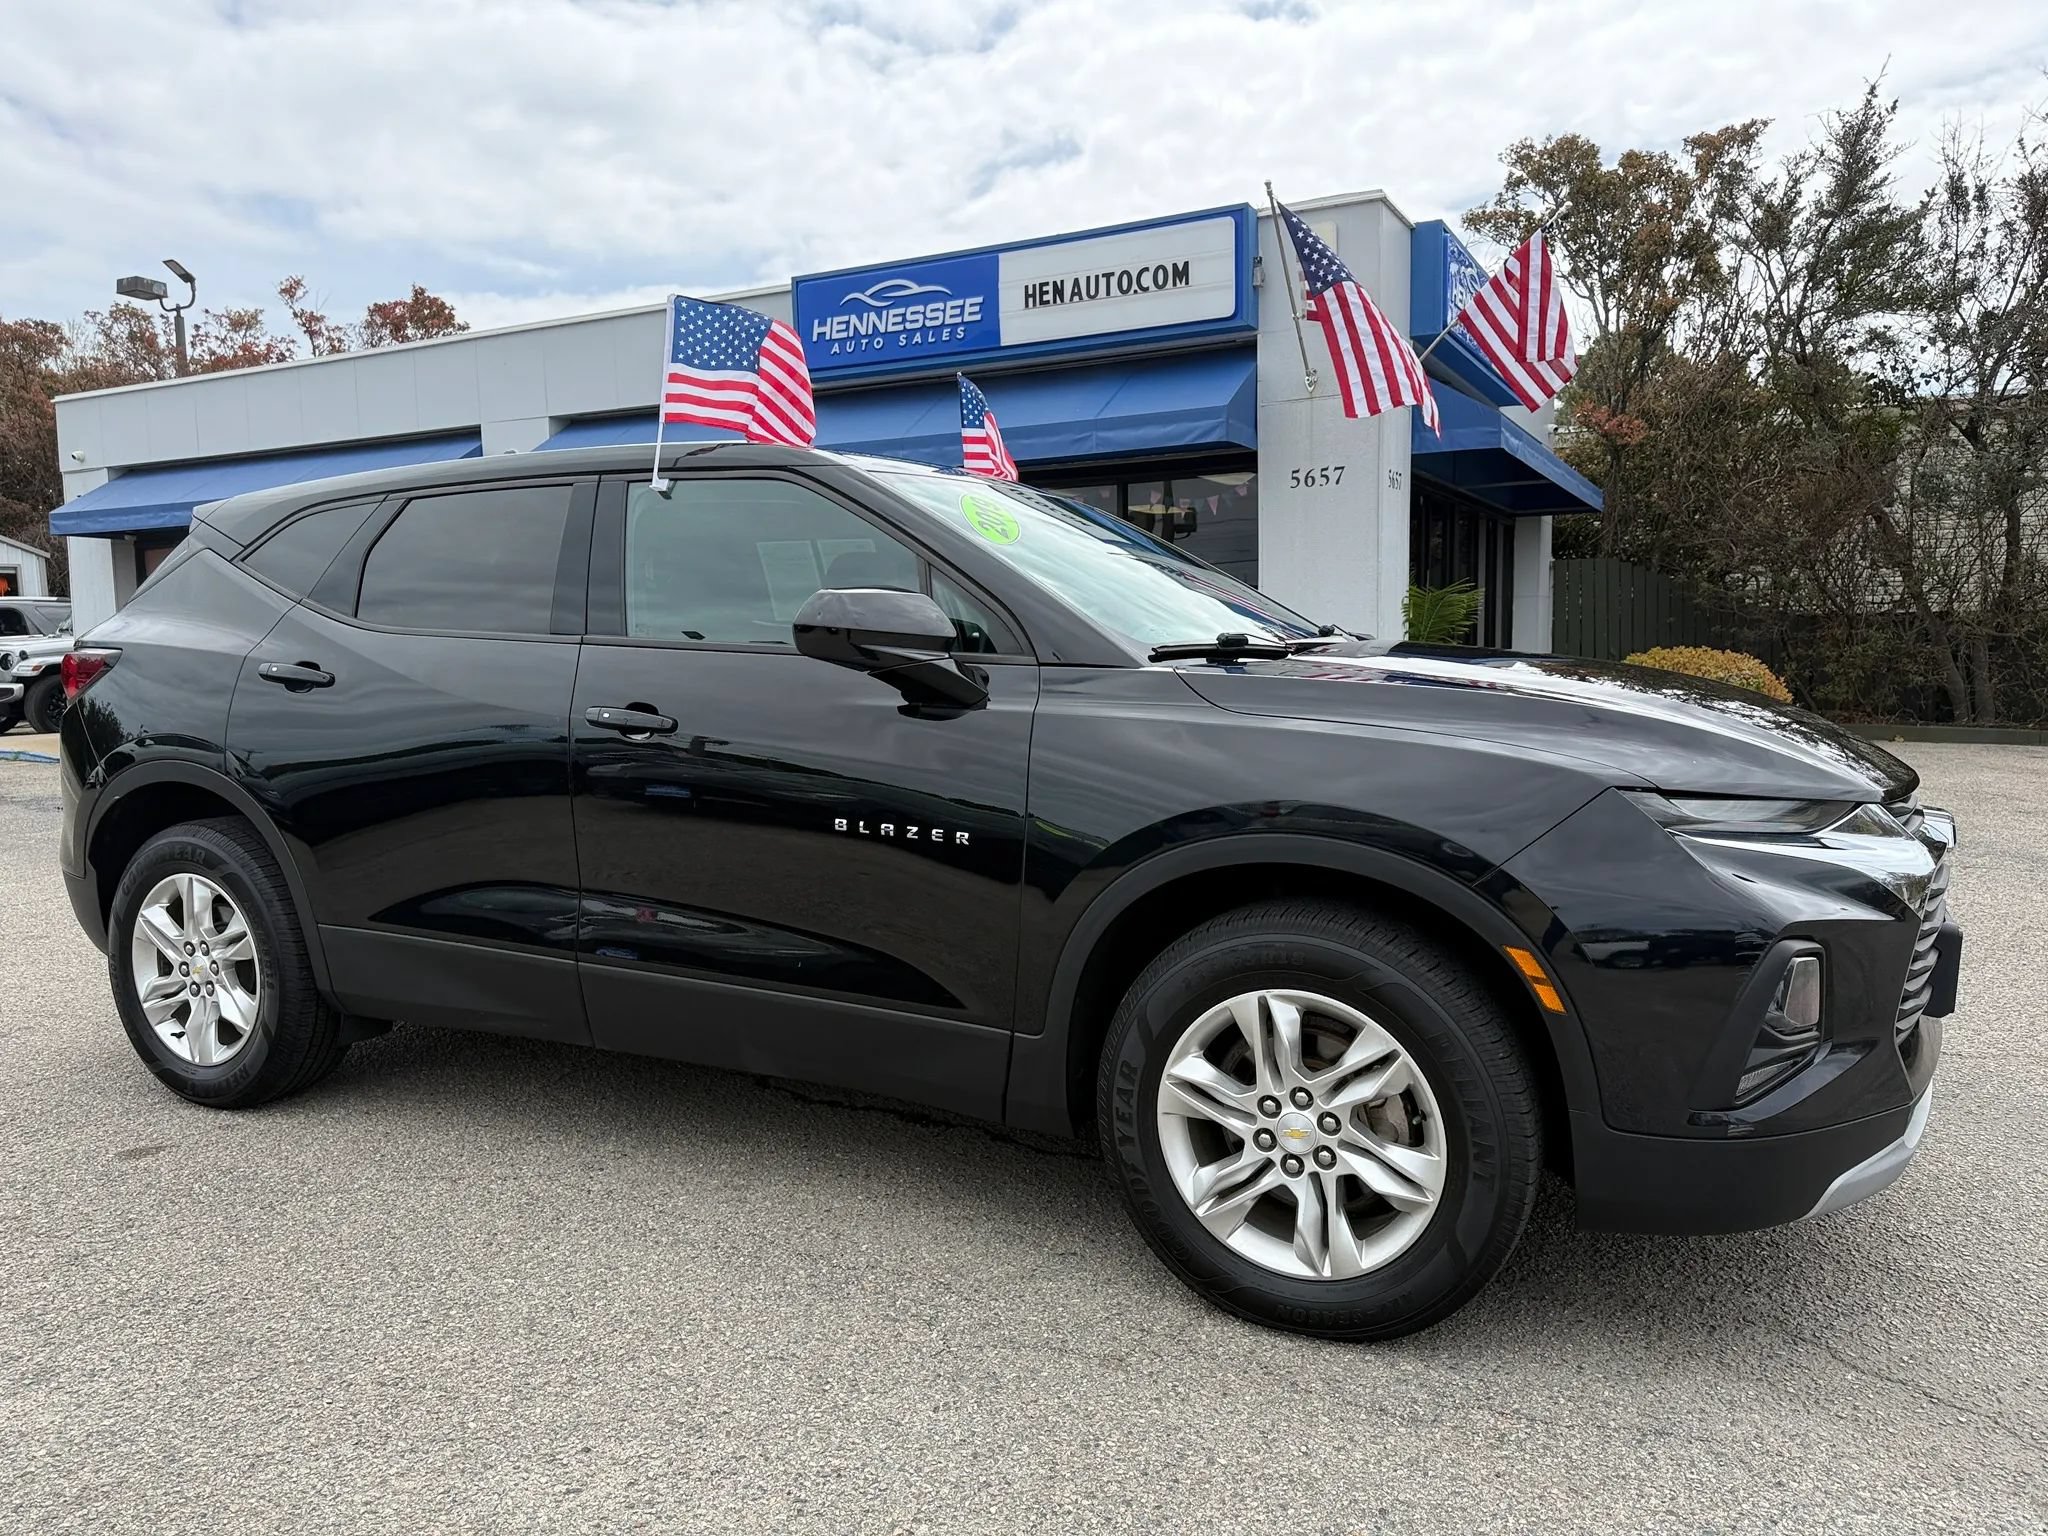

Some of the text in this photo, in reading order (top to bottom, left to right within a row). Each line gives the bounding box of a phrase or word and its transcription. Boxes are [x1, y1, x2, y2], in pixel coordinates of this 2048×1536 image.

[812, 297, 984, 342] HENNESSEE
[831, 326, 966, 355] AUTO SALES
[1289, 465, 1346, 489] 5657
[1387, 469, 1402, 491] 5657
[969, 496, 1010, 539] 2019
[834, 818, 970, 846] BLAZER
